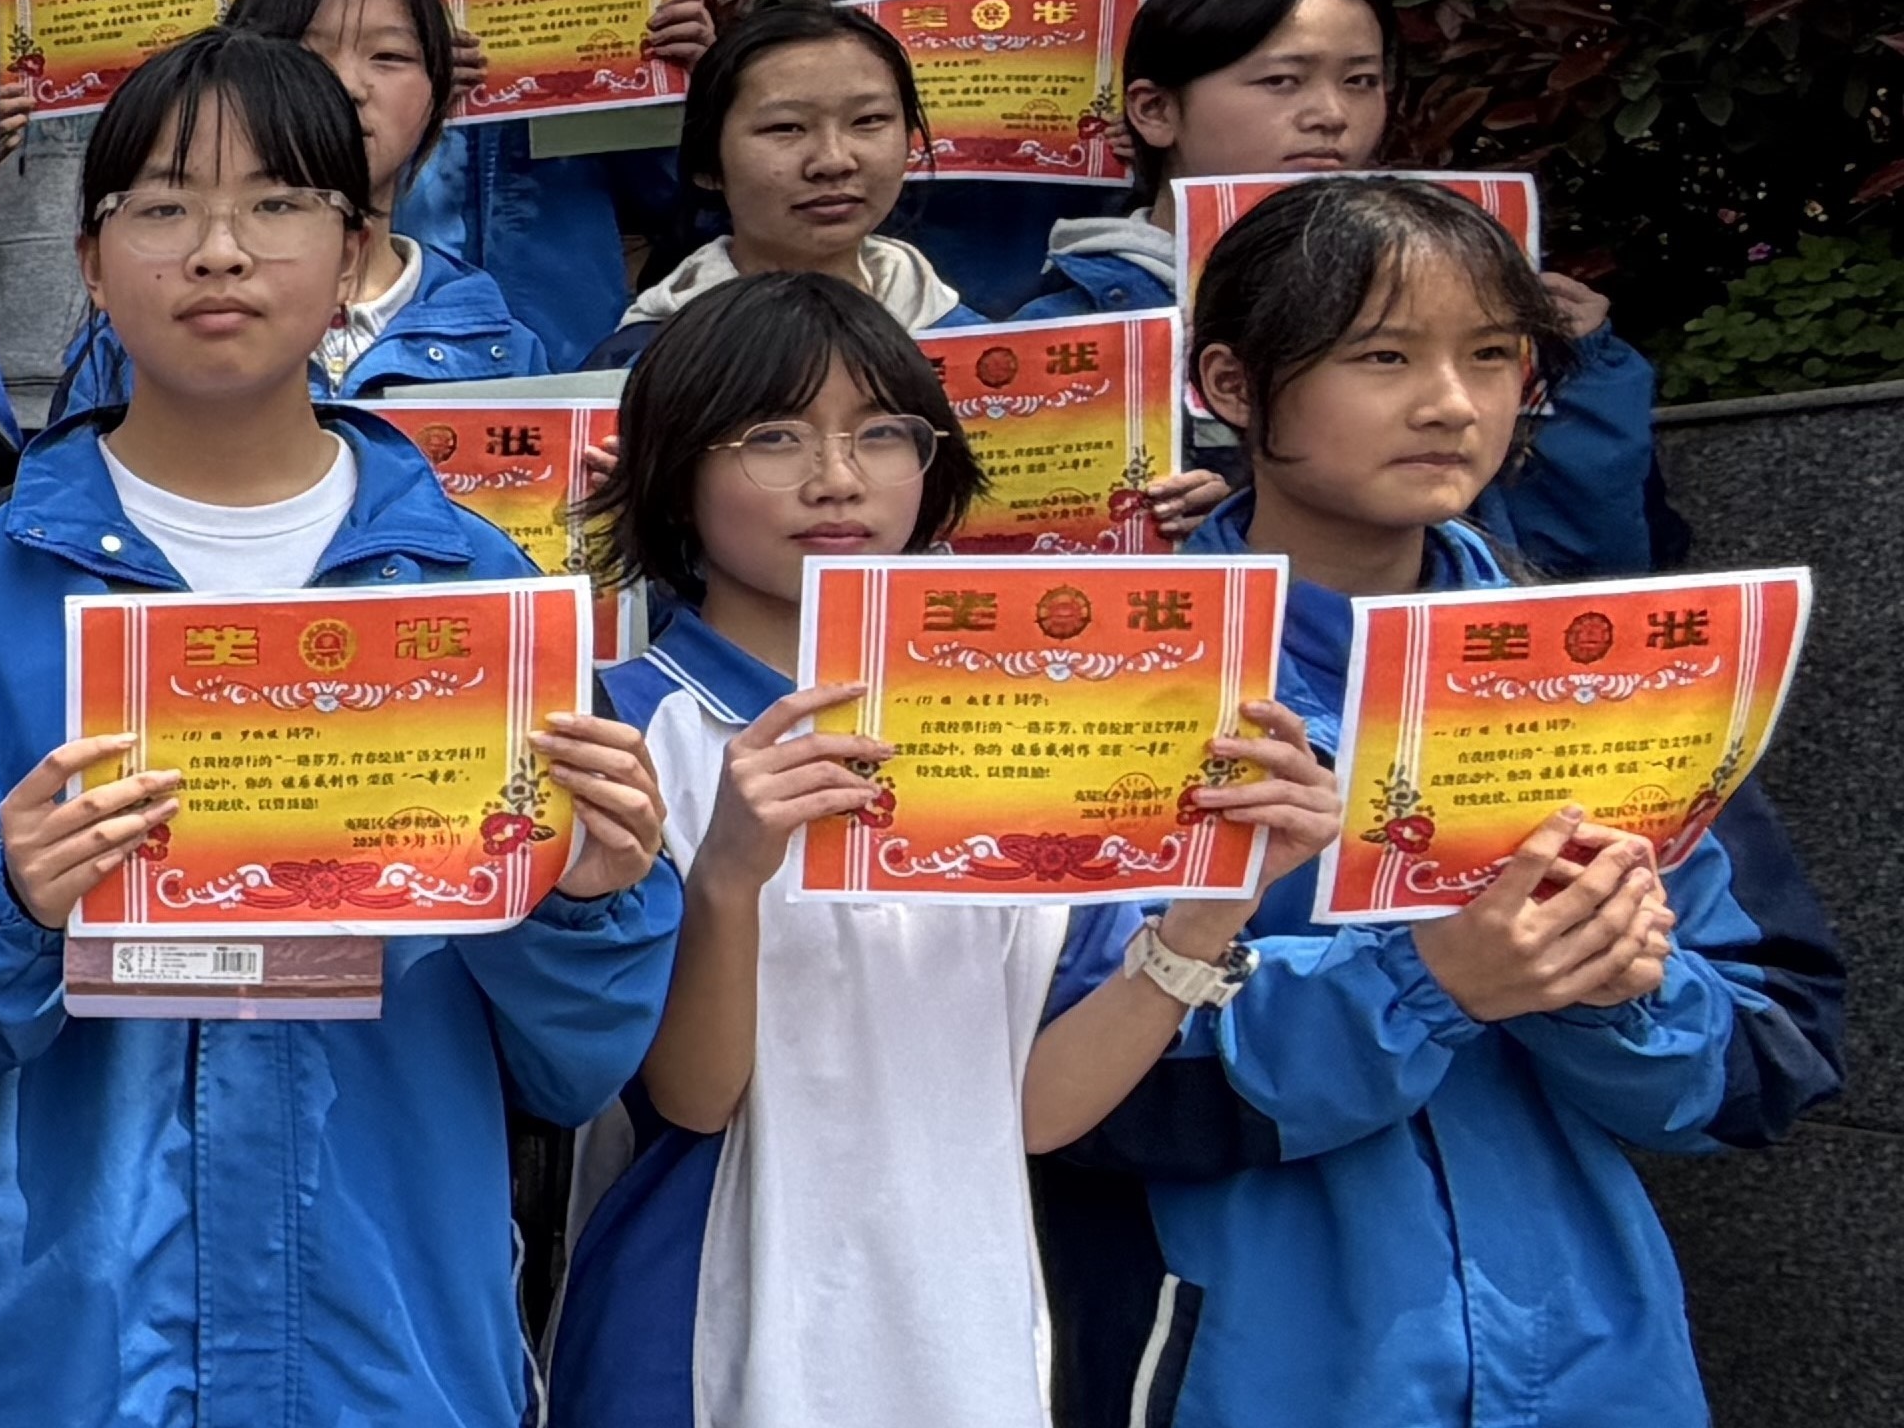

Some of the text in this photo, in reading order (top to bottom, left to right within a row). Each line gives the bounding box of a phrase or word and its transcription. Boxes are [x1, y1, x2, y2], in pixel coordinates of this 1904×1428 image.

[923, 590, 1194, 631] 奖 状
[184, 617, 472, 666] 奖 状
[1462, 609, 1709, 662] 奖 状
